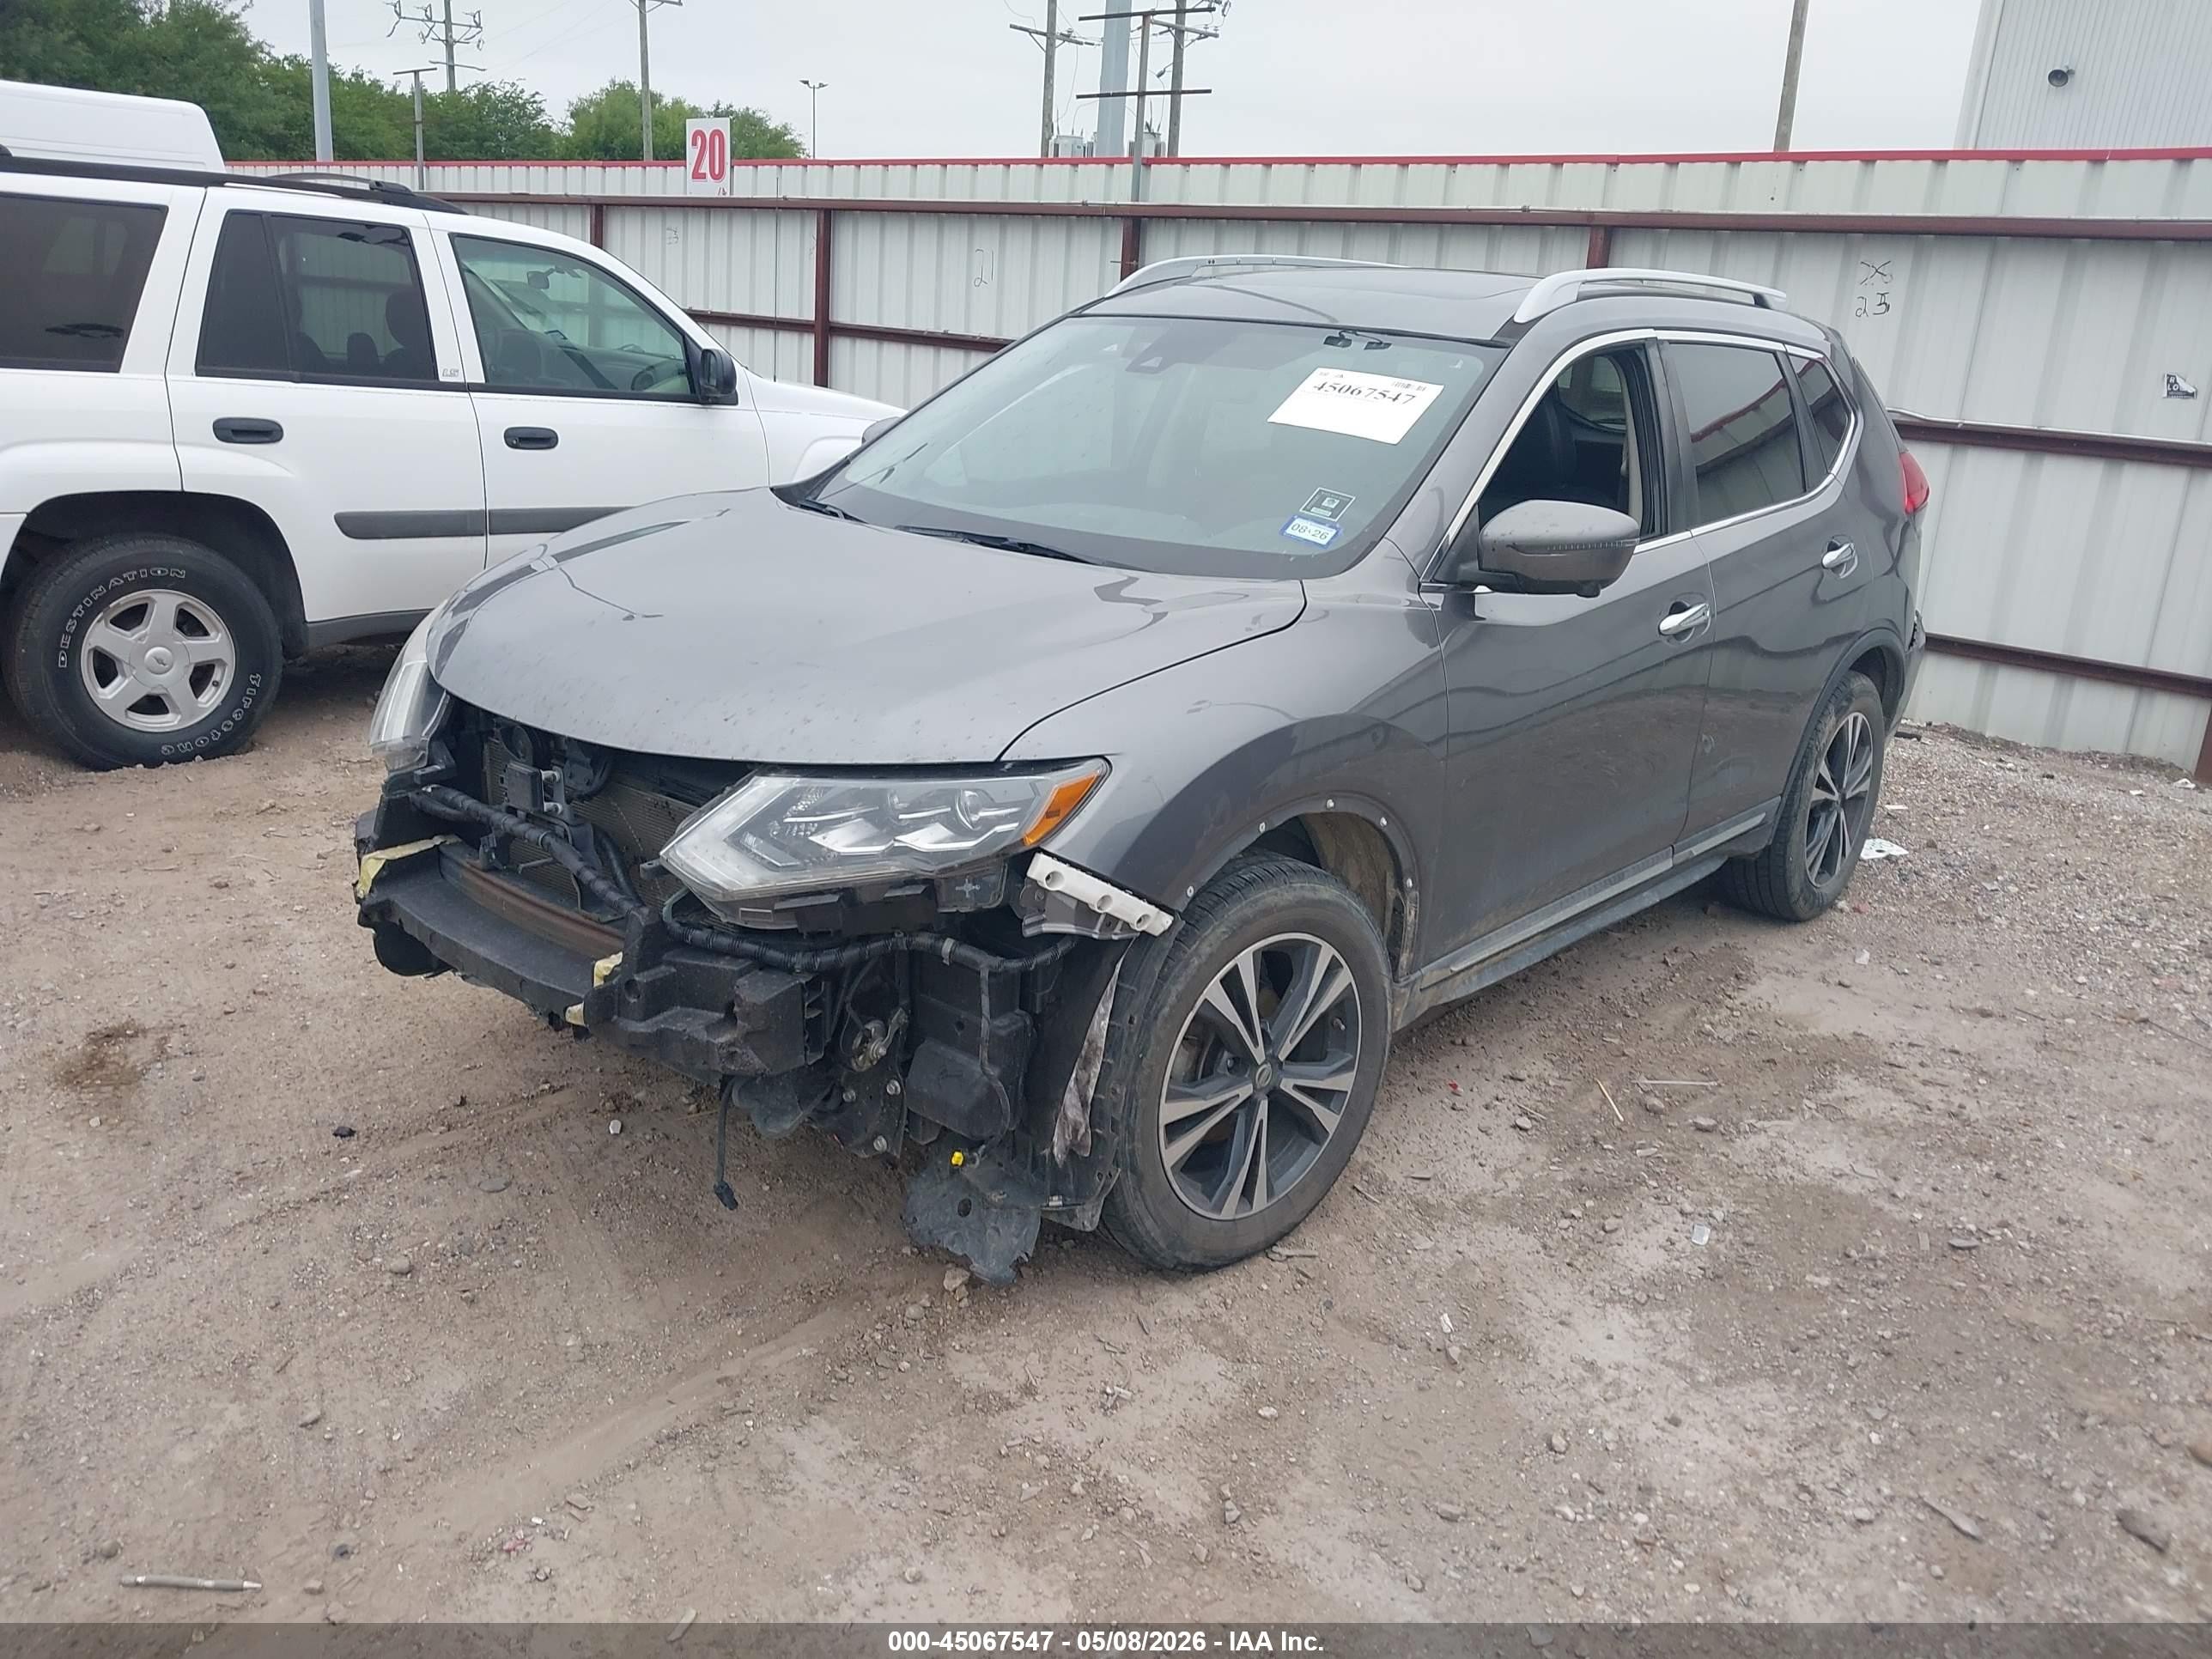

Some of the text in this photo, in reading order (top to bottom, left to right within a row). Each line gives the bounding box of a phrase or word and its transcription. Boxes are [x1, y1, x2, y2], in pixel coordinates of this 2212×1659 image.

[691, 129, 726, 183] 20
[1313, 381, 1417, 404] 45067547
[58, 567, 186, 668] DESTINATION
